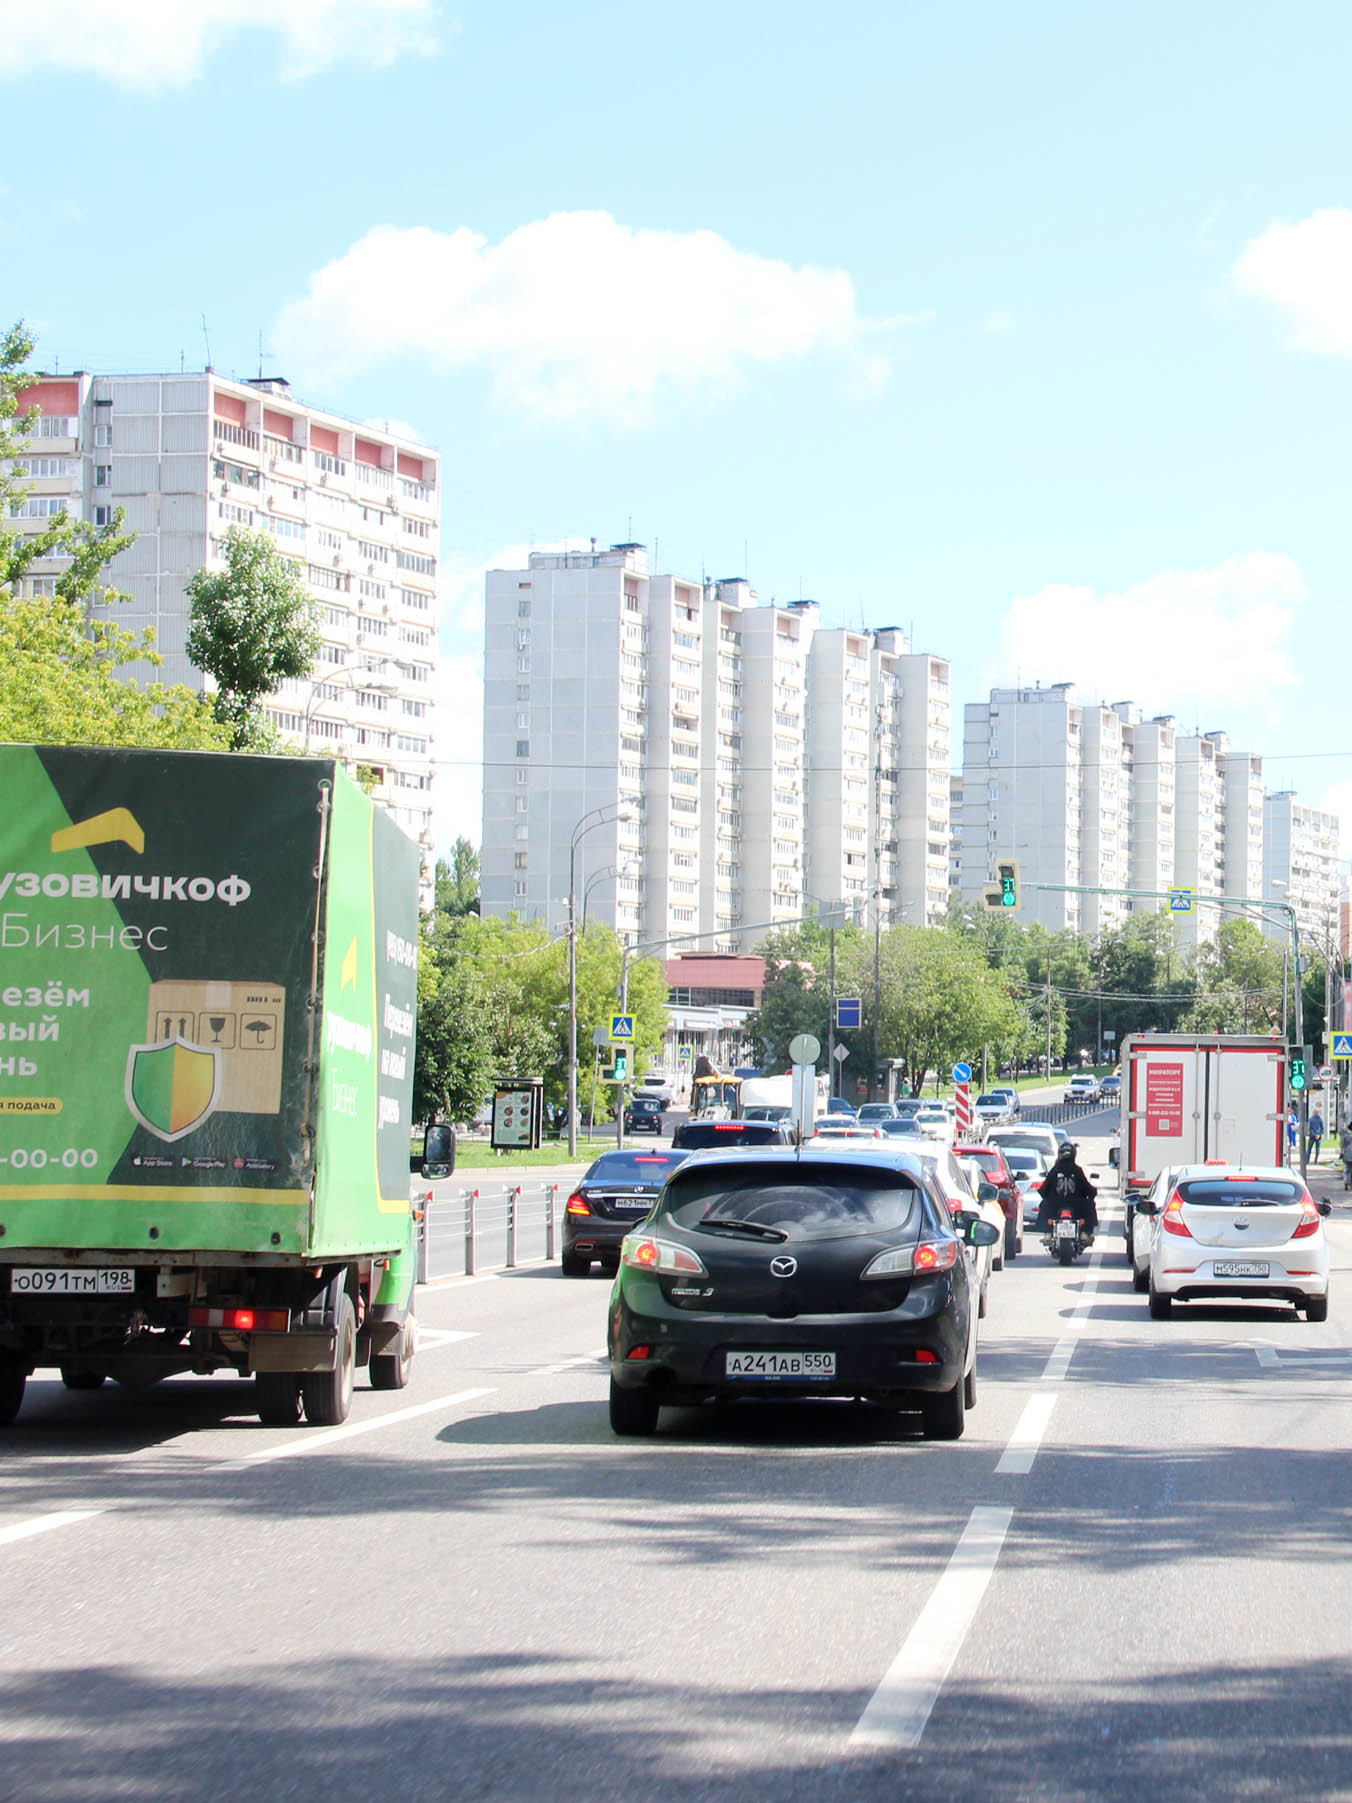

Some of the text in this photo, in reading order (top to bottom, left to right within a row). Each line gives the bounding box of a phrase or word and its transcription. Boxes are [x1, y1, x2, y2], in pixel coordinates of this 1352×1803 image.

[1, 913, 168, 951] Бизнес
[8, 1102, 56, 1110] подача
[804, 1354, 832, 1368] 550
